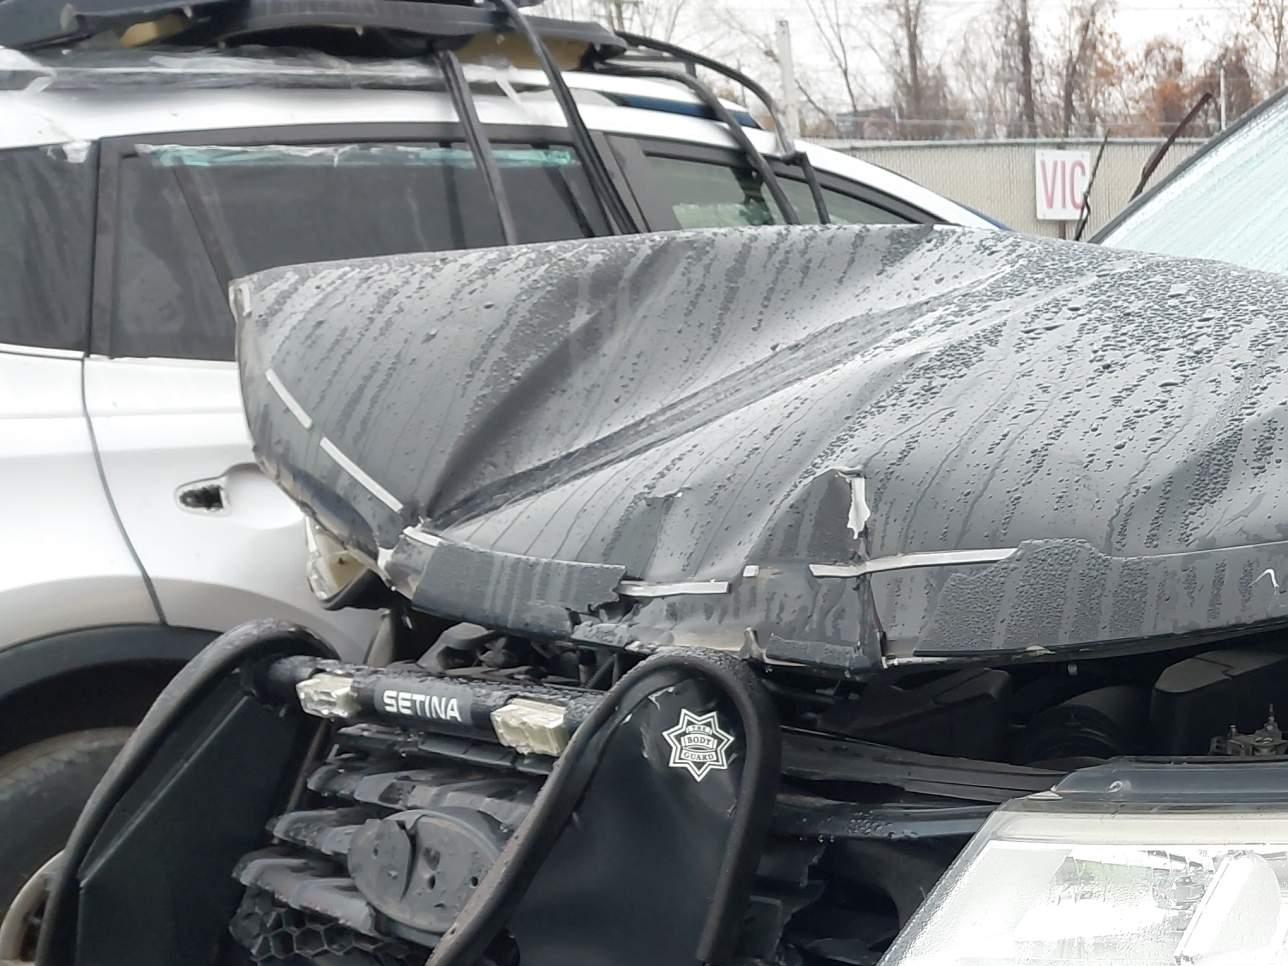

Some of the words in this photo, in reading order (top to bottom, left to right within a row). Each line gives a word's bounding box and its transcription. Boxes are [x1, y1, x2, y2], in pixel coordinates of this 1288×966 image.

[1040, 159, 1086, 210] VIC
[383, 690, 462, 722] SETINA
[687, 736, 712, 746] BODY
[683, 751, 714, 761] GUARD
